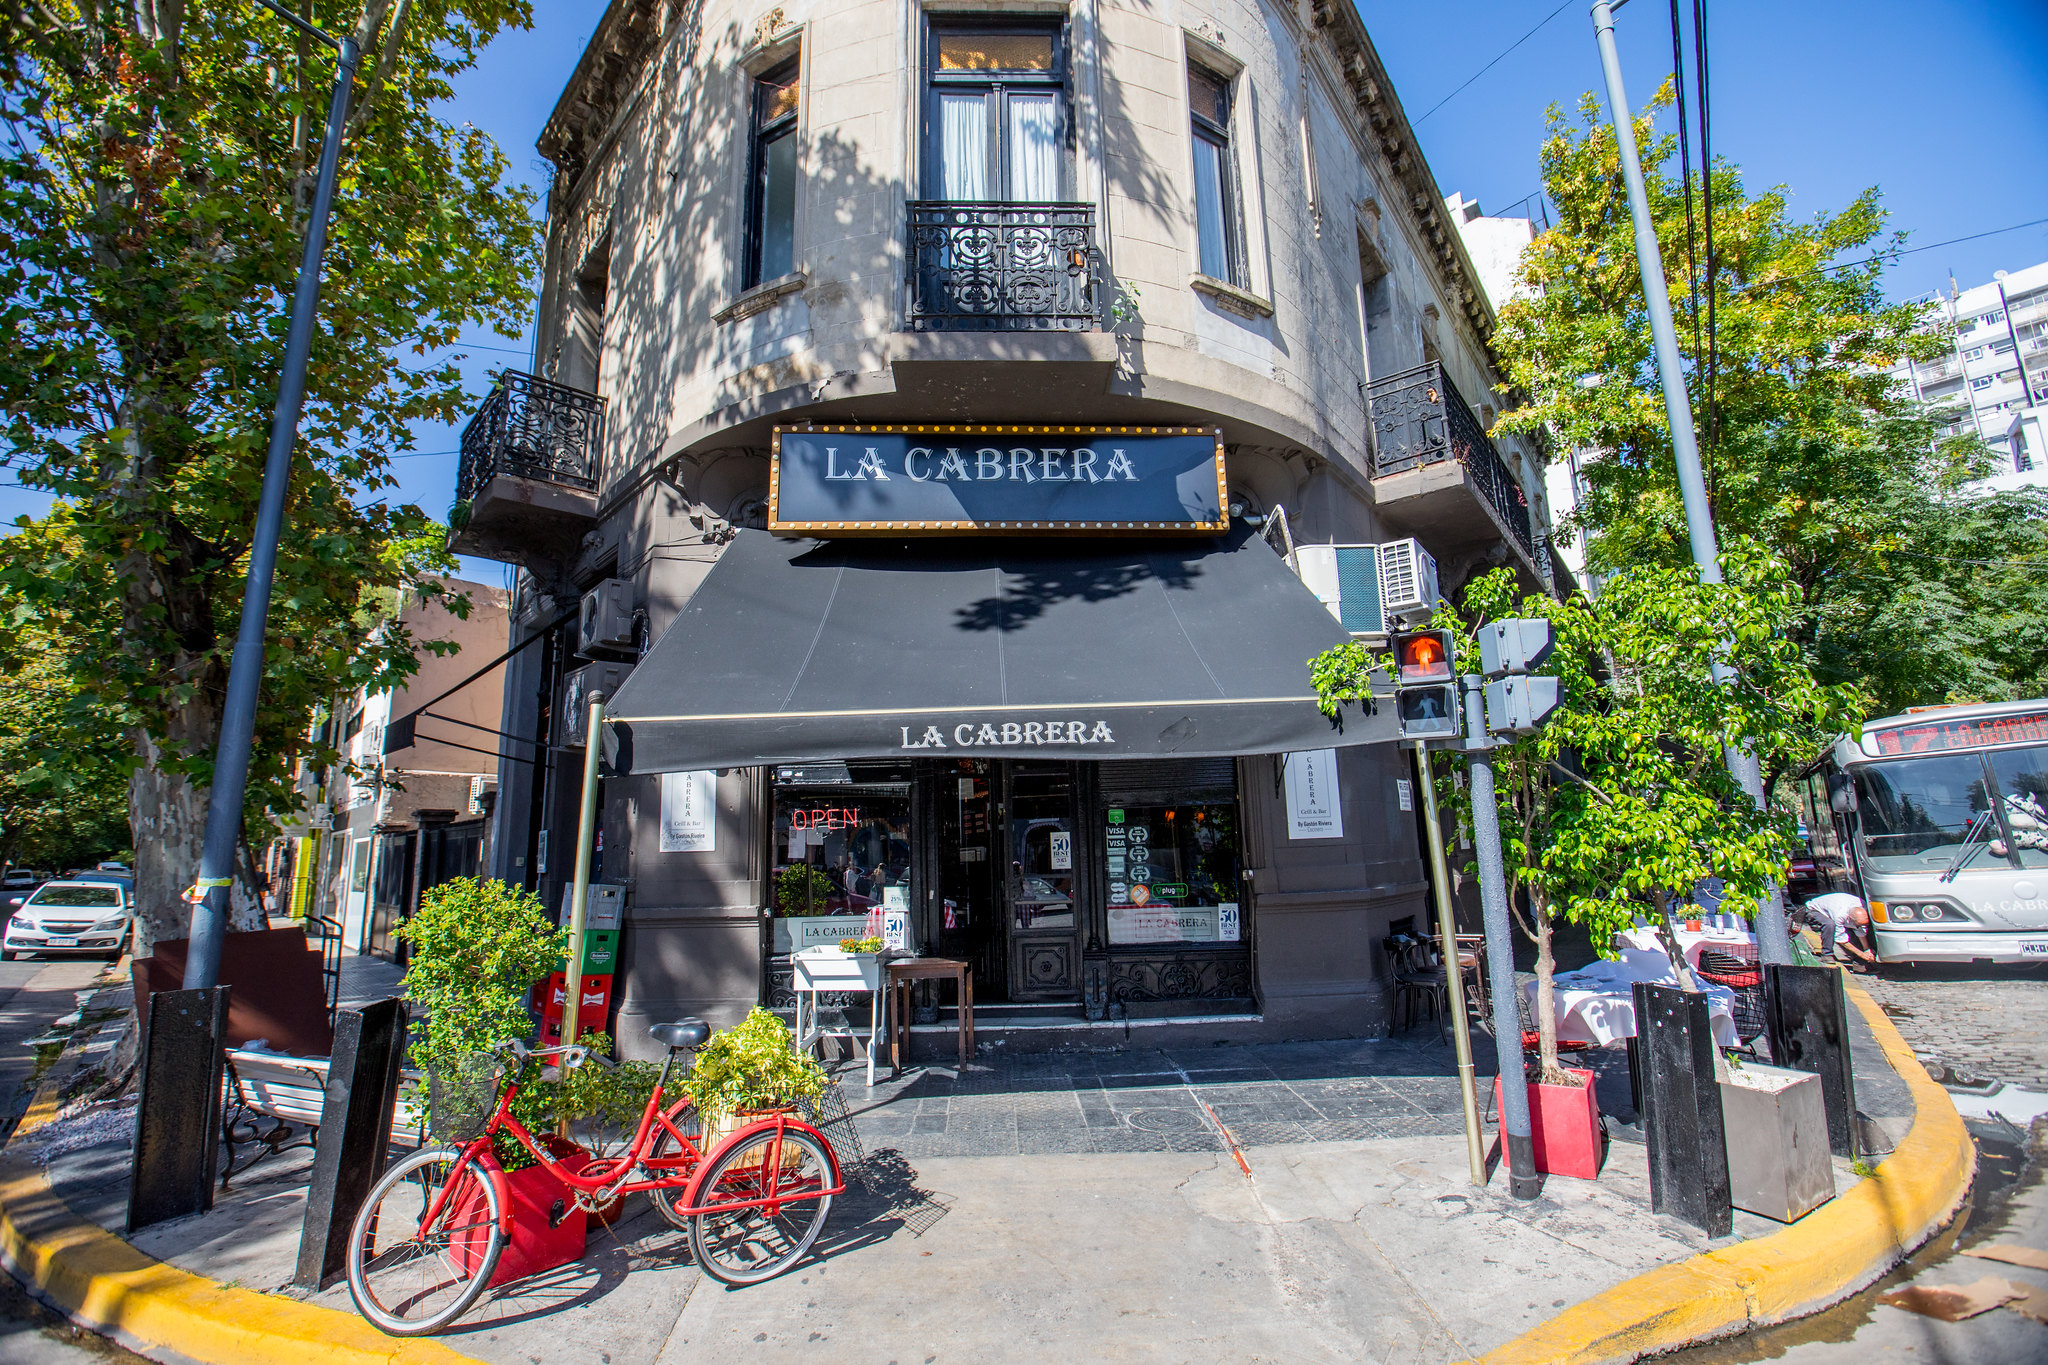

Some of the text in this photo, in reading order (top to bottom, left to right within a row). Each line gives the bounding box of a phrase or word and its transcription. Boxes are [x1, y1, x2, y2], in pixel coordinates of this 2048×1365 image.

[824, 446, 1141, 485] LA CABRERA
[900, 720, 1116, 749] LA CABRERA
[1306, 756, 1316, 806] CABRERA
[793, 807, 857, 831] OPEN
[1108, 827, 1125, 835] VISA
[1052, 838, 1070, 851] 50
[1971, 901, 1996, 912] LA
[1220, 909, 1237, 923] 50
[805, 927, 820, 937] LA
[885, 919, 903, 932] 50
